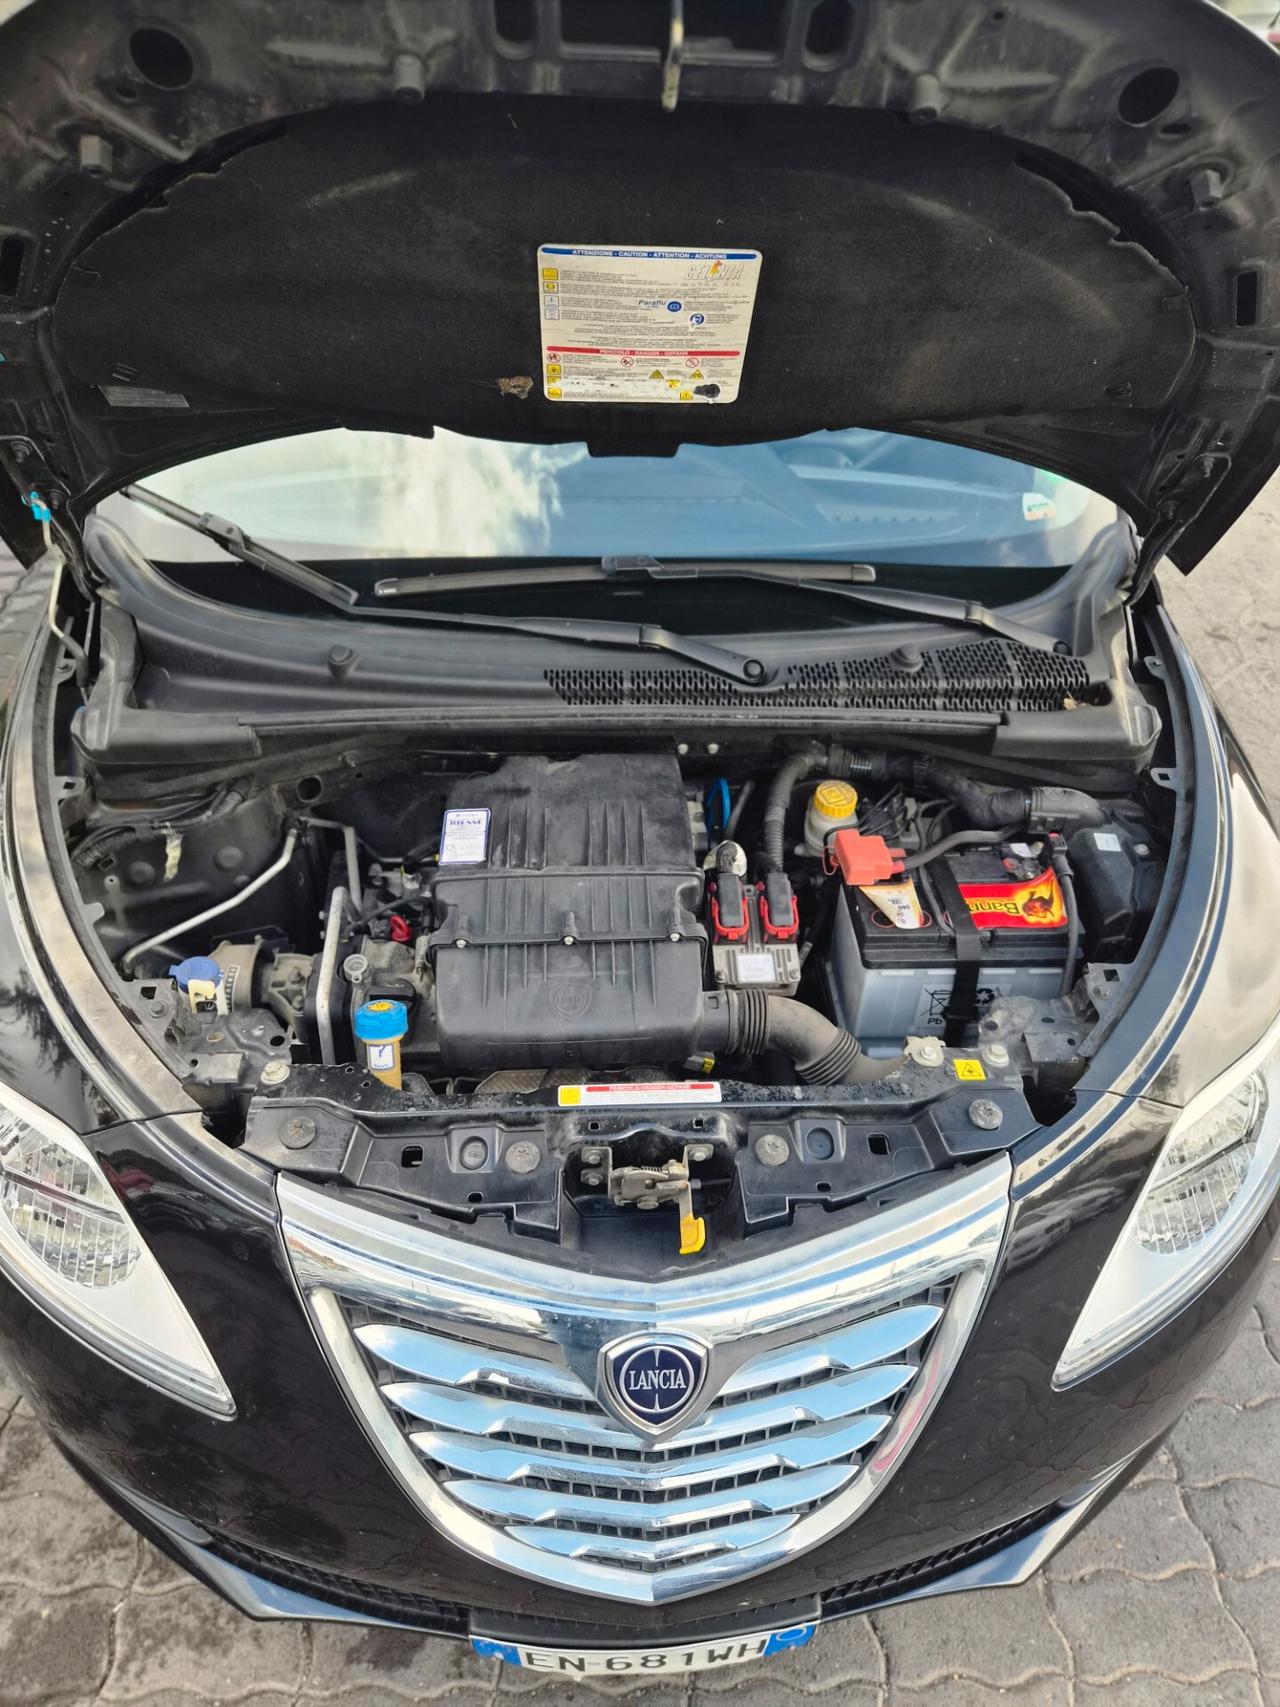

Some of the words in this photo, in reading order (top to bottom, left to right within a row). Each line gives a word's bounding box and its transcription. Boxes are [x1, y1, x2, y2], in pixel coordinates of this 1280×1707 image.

[618, 250, 648, 258] CAUTION
[927, 1017, 943, 1025] Pb
[628, 1368, 687, 1391] LANCIA
